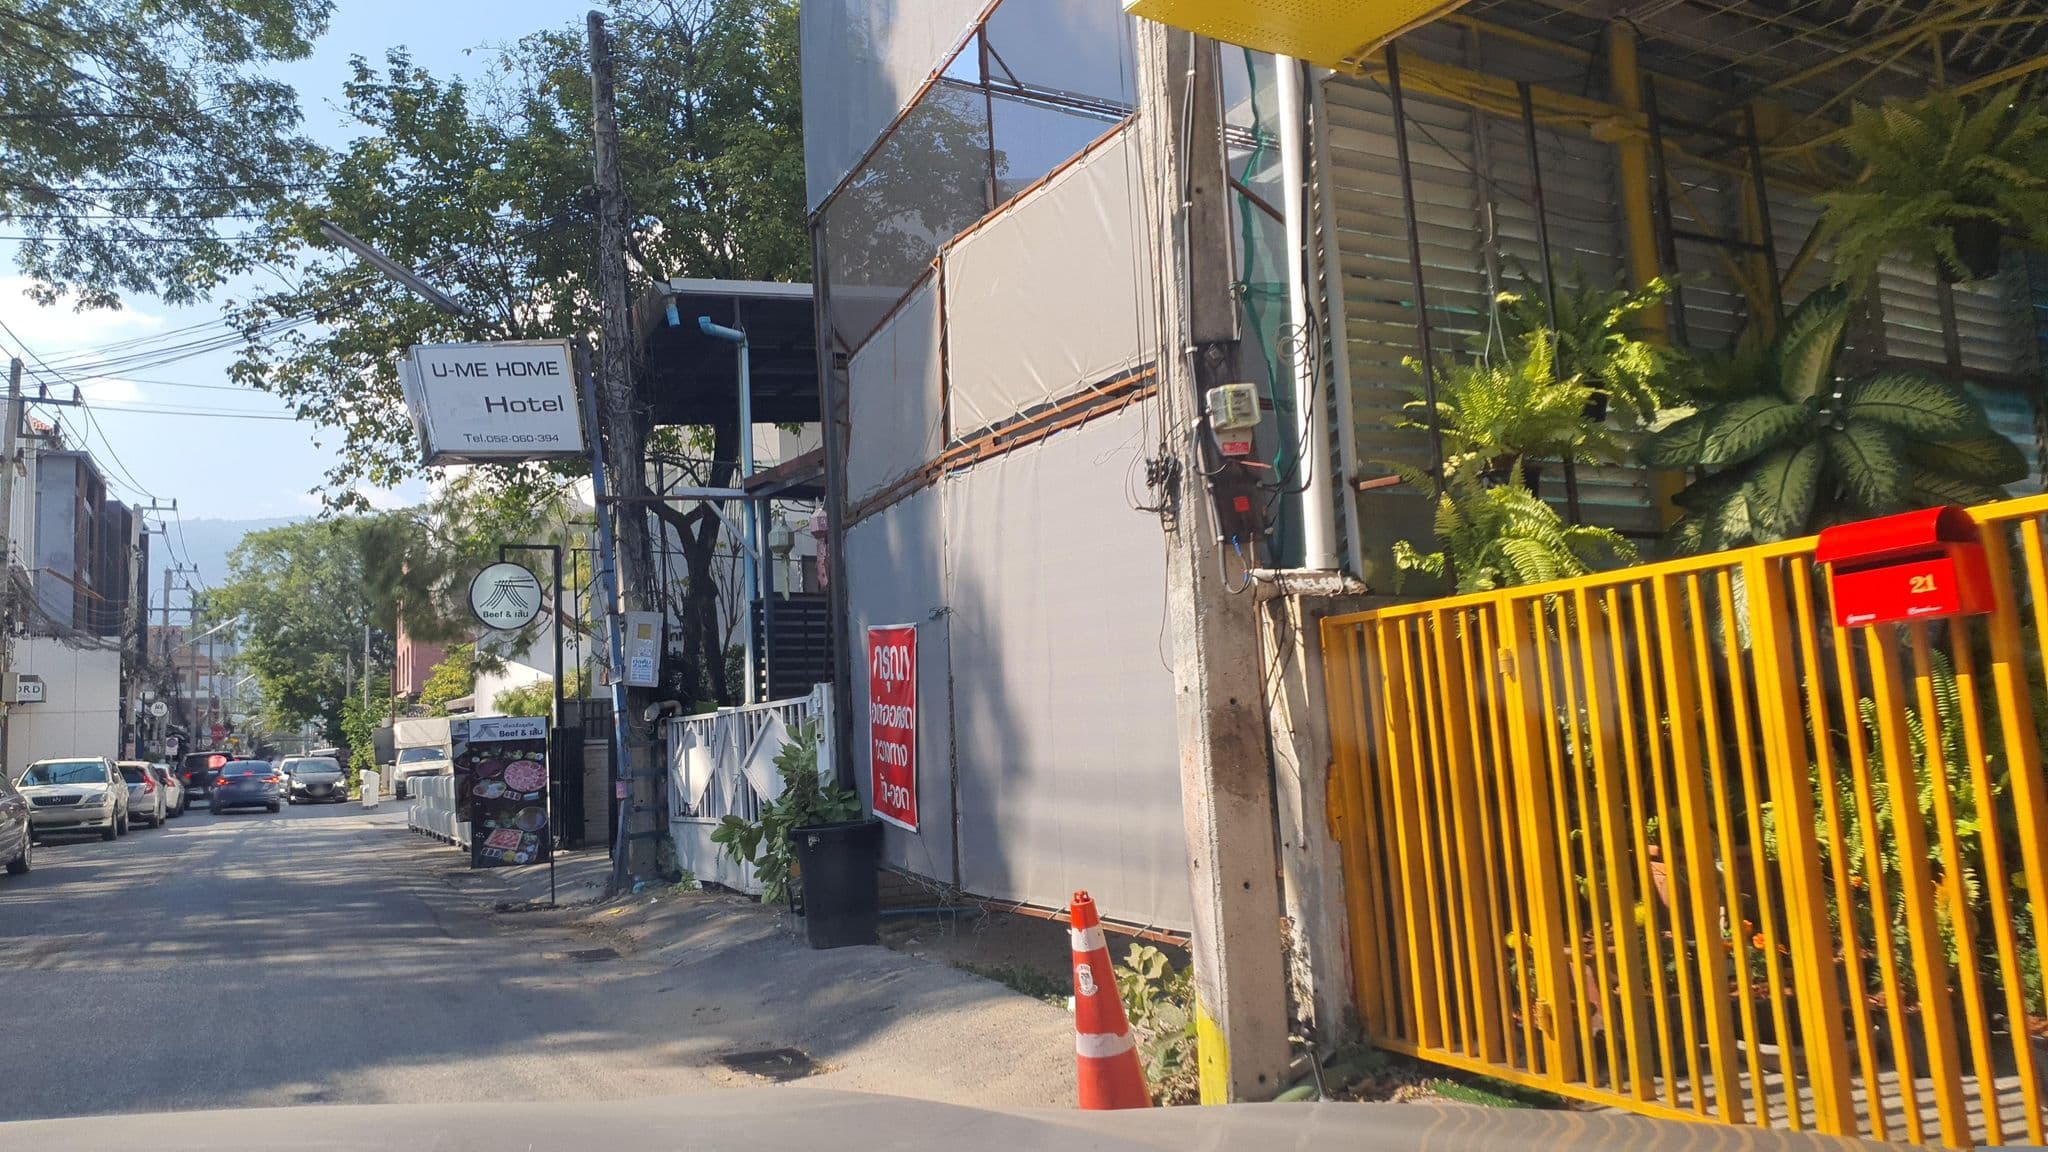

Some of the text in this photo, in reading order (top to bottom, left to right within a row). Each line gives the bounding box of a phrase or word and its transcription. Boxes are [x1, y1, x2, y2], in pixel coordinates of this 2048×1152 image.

[432, 361, 560, 377] U-ME HOME
[485, 395, 564, 413] Hotel
[1909, 574, 1937, 593] 21
[483, 610, 503, 618] Beef
[505, 610, 512, 618] &
[873, 645, 910, 693] กรุณา
[529, 727, 543, 736] เส้น
